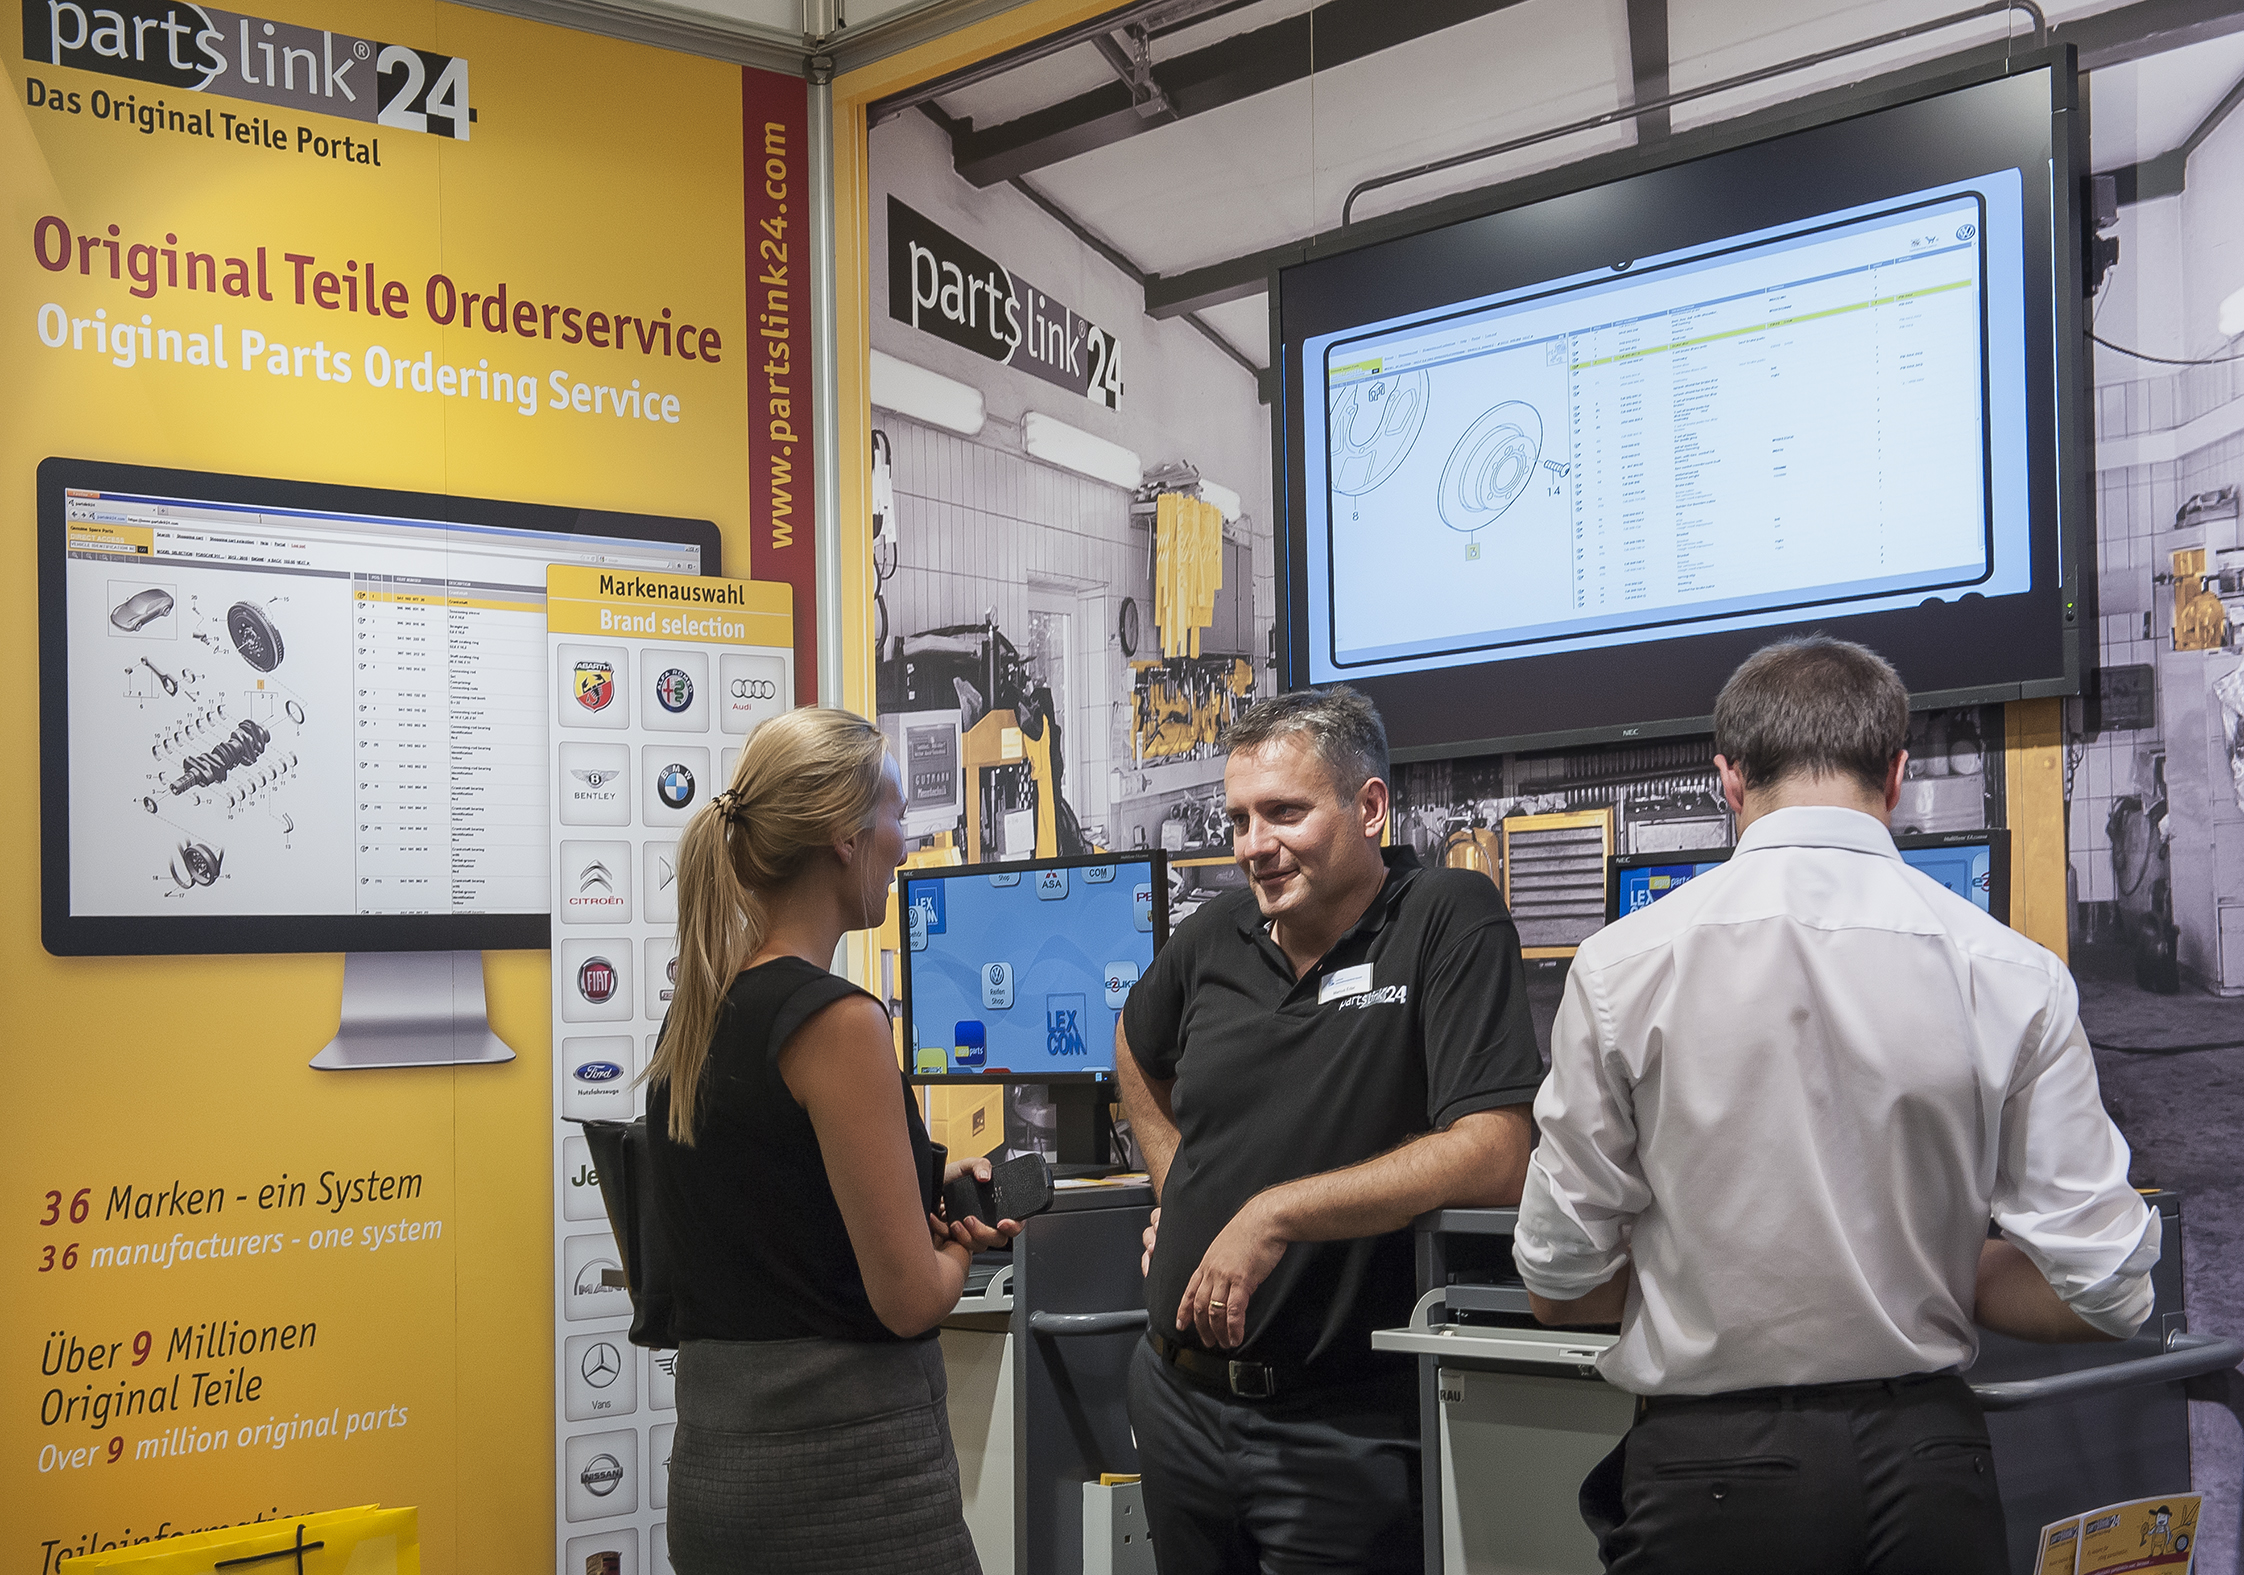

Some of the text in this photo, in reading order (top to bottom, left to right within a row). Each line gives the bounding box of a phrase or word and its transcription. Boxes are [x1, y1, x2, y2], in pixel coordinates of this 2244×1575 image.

[26, 78, 382, 167] Das Original Teile Portal
[33, 215, 723, 363] Original Teile Orderservice
[759, 121, 798, 549] www.partslink24.com
[37, 302, 681, 424] Original Parts Ordering Service
[1548, 485, 1561, 497] 14
[1352, 512, 1359, 521] 8
[600, 575, 745, 605] Markenauswahl
[600, 609, 745, 639] Brand selection
[576, 663, 609, 671] ABARTH
[657, 669, 692, 693] ALFA ROMEO
[732, 703, 752, 711] Audi
[1042, 880, 1062, 888] ASA
[587, 970, 609, 991] FIAT
[1047, 1010, 1077, 1033] LEX
[1047, 1033, 1087, 1056] COM
[584, 1065, 612, 1079] Ford
[577, 1088, 619, 1096] Nutzfahrzeuge
[39, 1188, 91, 1227] 36
[105, 1180, 225, 1221] Marken
[258, 1173, 306, 1210] ein
[316, 1170, 423, 1213] System
[37, 1243, 80, 1273] 36
[90, 1228, 283, 1269] manufacturers
[308, 1226, 354, 1251] one
[360, 1217, 443, 1251] system
[41, 1320, 317, 1376] Über 9 Millionen
[40, 1366, 262, 1430] Original Teile
[592, 1400, 611, 1410] Vans
[38, 1403, 408, 1473] Over 9 million original parts
[584, 1470, 619, 1481] NISSAN
